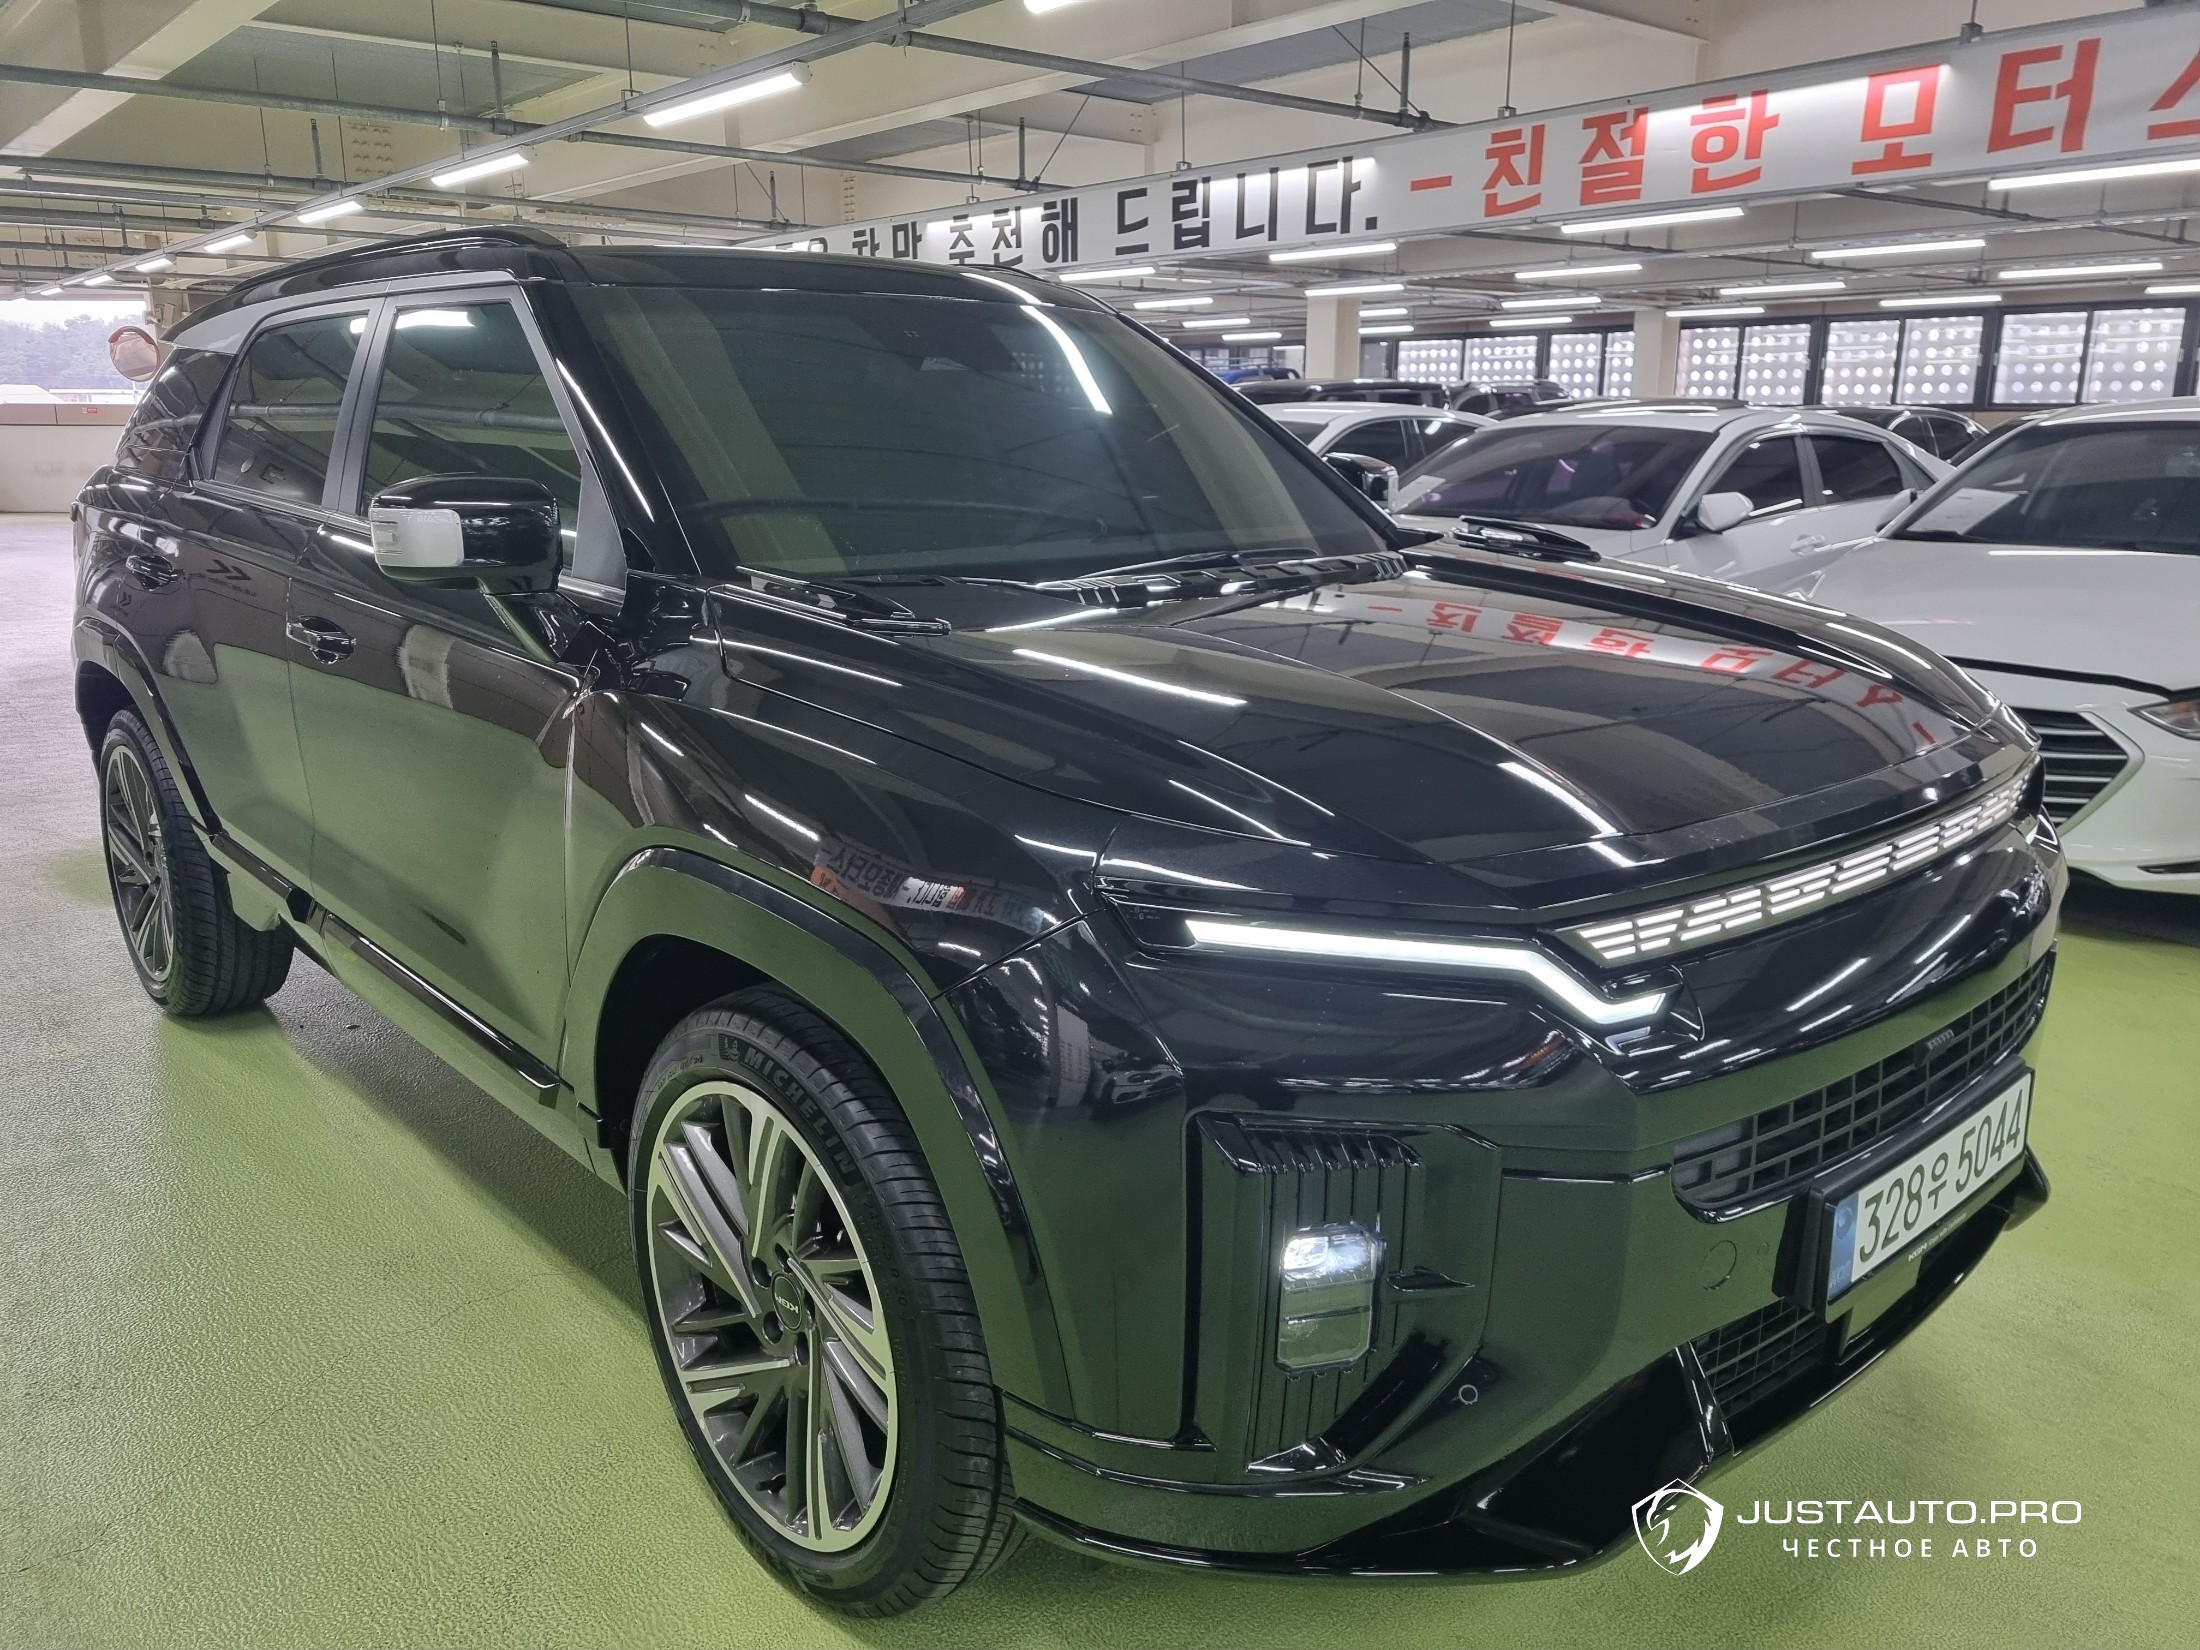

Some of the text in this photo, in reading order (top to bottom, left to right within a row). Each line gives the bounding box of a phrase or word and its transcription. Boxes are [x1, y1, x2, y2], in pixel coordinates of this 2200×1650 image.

[949, 196, 1078, 267] 추천해
[1115, 156, 1378, 255] 드립니다.
[1482, 90, 1779, 218] 친절한
[744, 1048, 857, 1173] MICHELIN
[1860, 1089, 2023, 1262] 328우 5044
